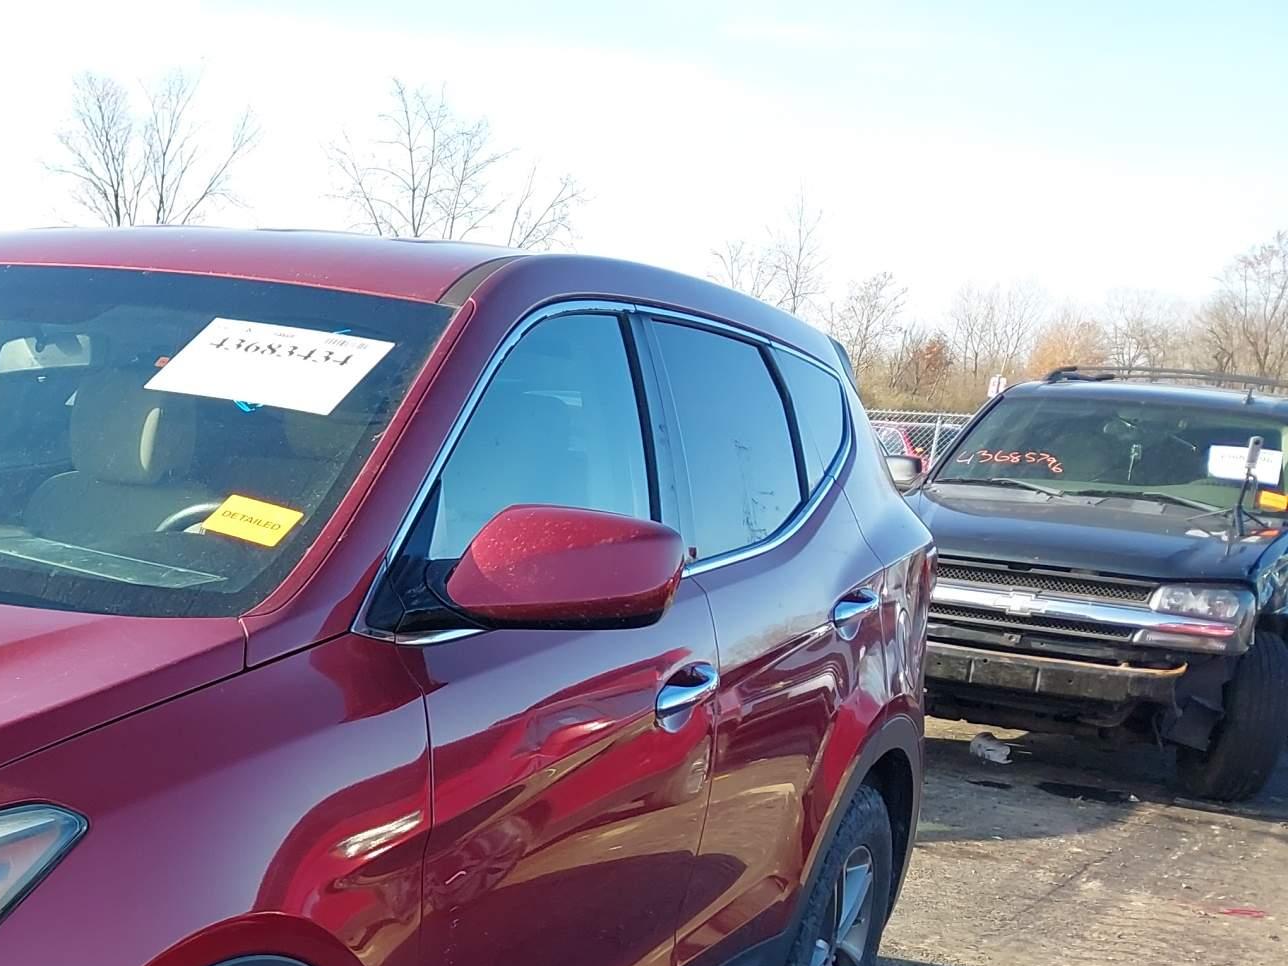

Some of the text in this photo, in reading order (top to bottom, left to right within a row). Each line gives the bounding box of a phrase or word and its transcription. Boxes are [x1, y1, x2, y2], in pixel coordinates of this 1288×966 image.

[209, 335, 353, 367] 43683434
[956, 448, 1064, 474] 43685796
[221, 510, 281, 531] DETAILED
